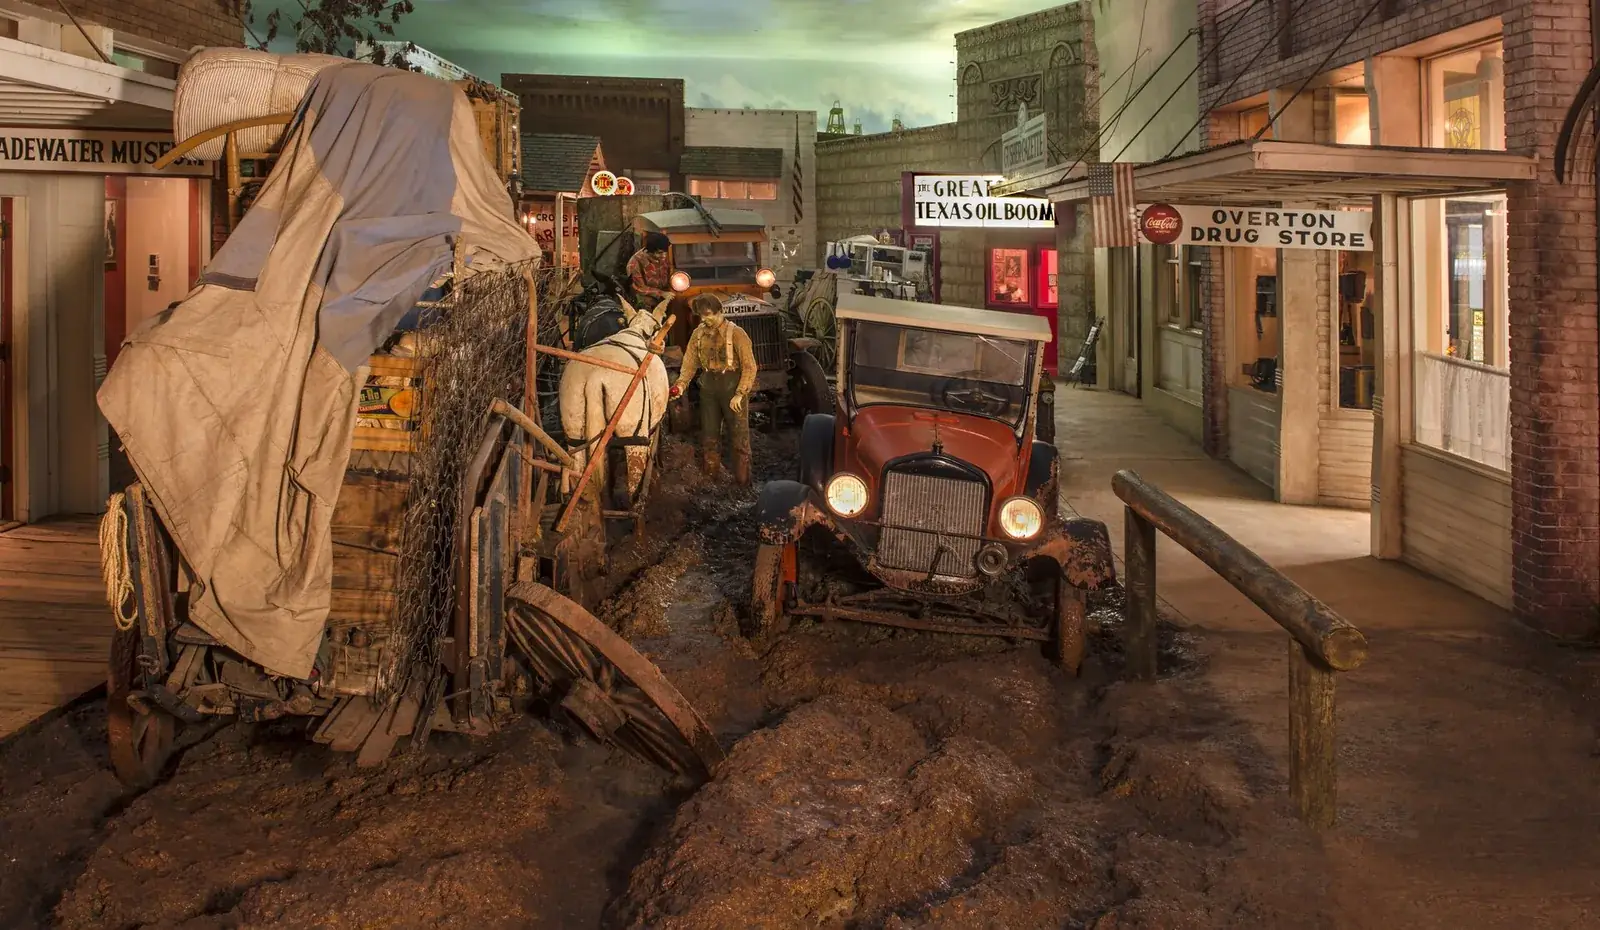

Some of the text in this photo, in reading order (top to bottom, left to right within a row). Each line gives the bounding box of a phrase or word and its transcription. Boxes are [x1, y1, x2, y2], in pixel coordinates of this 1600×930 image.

[0, 137, 204, 166] ADEWATER MUSE
[933, 179, 993, 198] GREAT
[536, 213, 568, 222] CROS
[915, 201, 1058, 223] TEXAS OIL BOOM
[1211, 209, 1335, 229] OVERTON
[1145, 216, 1179, 229] Coca-Cola
[1190, 226, 1365, 247] DRUG STORE
[722, 303, 761, 314] WICHITA
